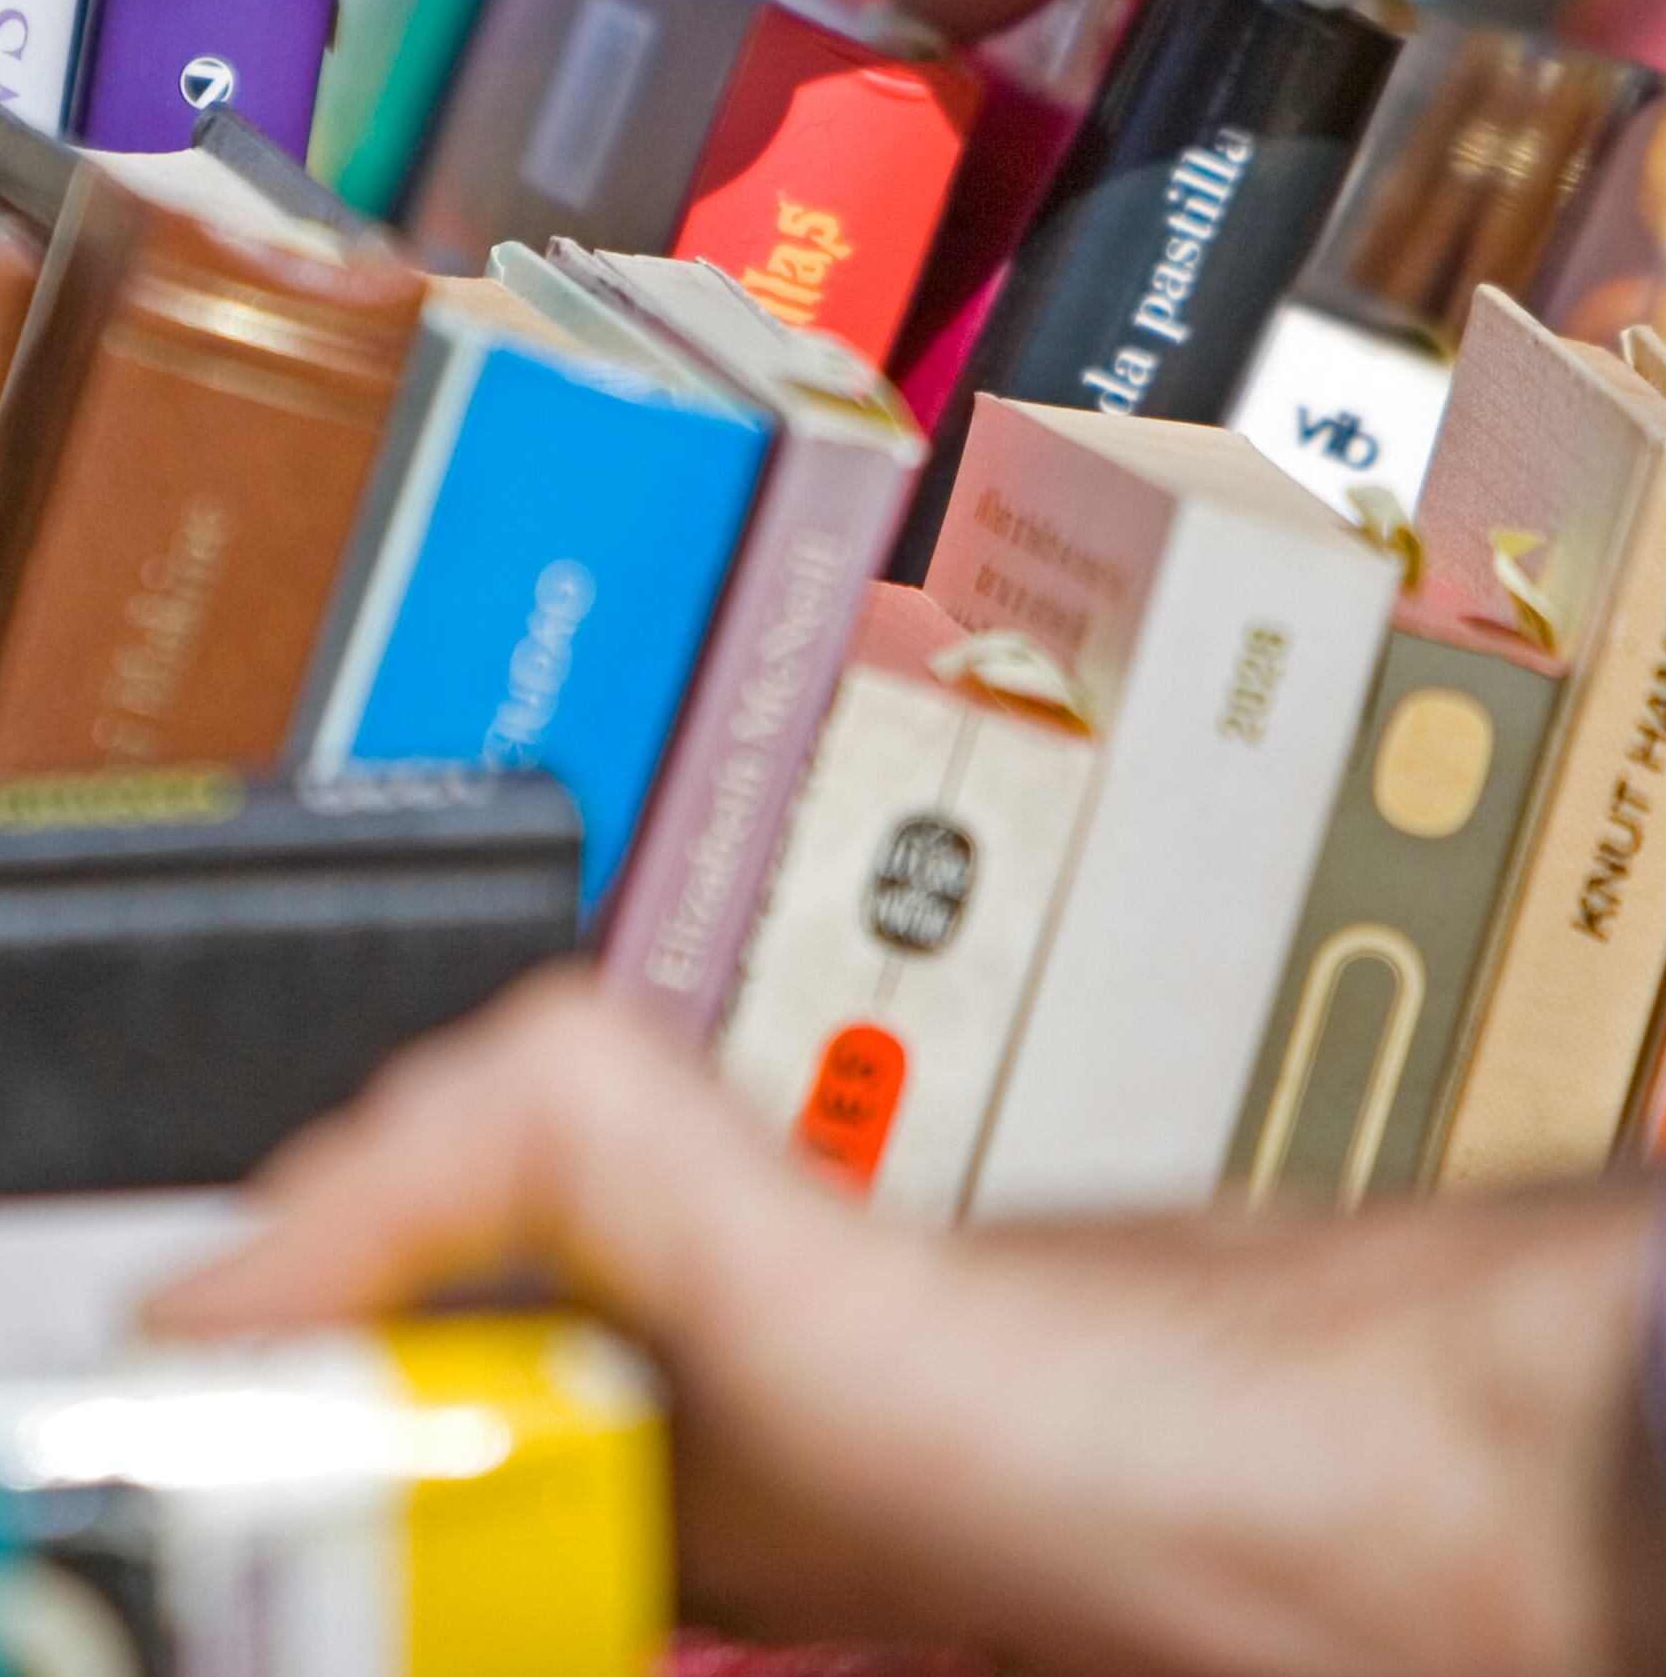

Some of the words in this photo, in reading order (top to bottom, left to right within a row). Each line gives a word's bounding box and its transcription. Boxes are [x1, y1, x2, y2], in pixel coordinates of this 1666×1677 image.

[1082, 344, 1161, 416] da
[1133, 126, 1253, 345] pastilla
[1571, 774, 1652, 944] KNUT
